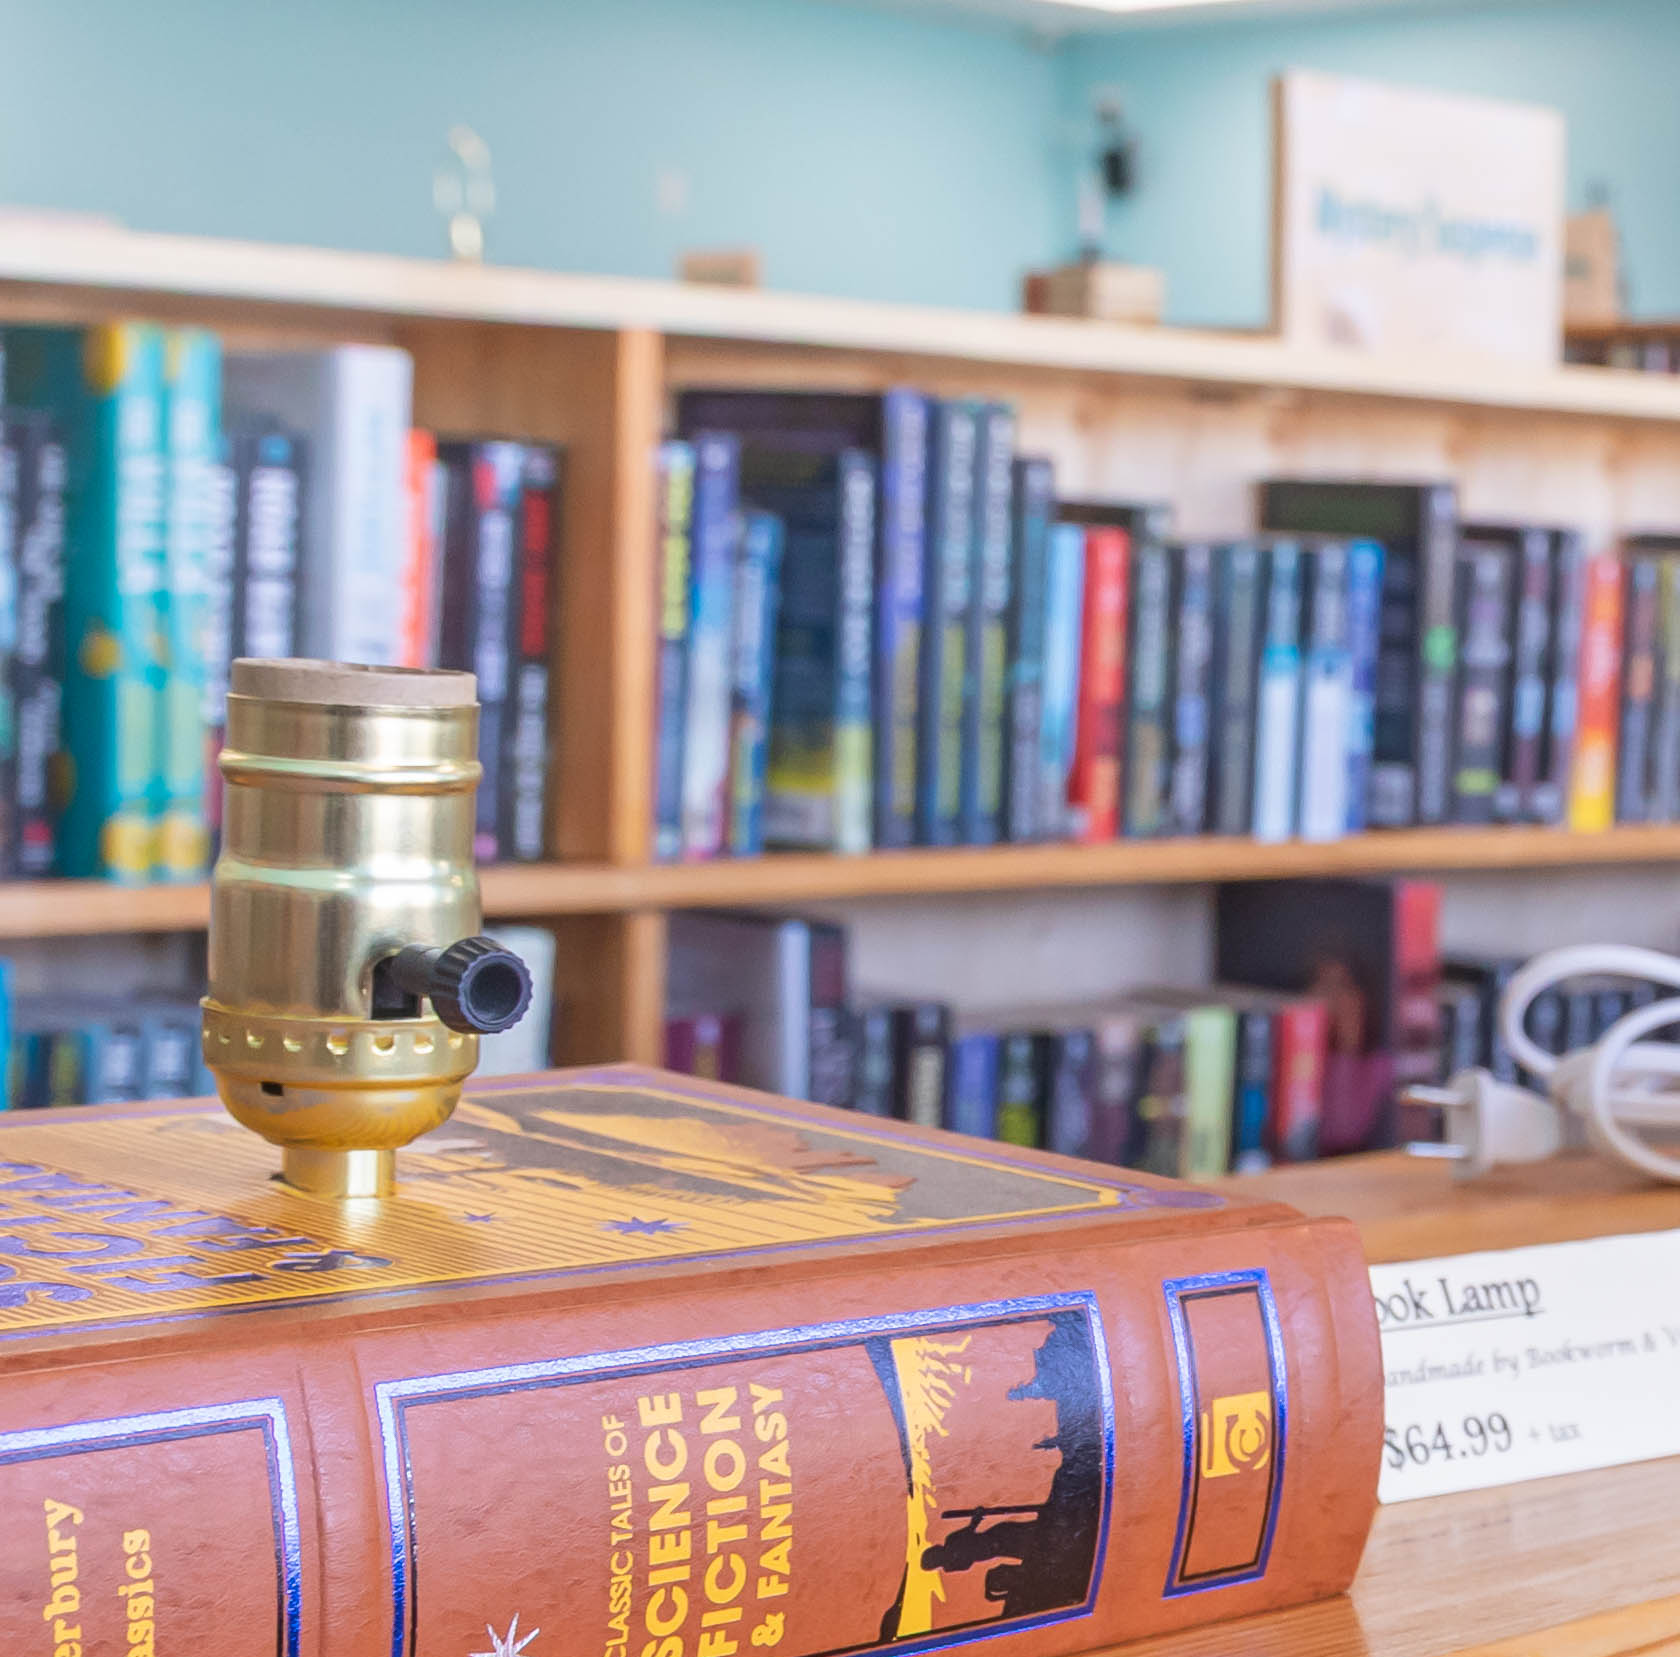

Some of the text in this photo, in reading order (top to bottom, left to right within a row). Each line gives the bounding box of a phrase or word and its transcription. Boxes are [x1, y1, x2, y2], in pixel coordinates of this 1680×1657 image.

[1374, 1277, 1542, 1324] ook Lamp
[1384, 1359, 1484, 1388] andmade
[1492, 1354, 1520, 1379] by
[1526, 1333, 1636, 1369] Bookworm
[602, 1415, 628, 1456] OF
[1384, 1412, 1514, 1471] $64.99
[1552, 1421, 1582, 1443] tax
[608, 1464, 633, 1546] TALES
[749, 1383, 793, 1647] & FANTASY
